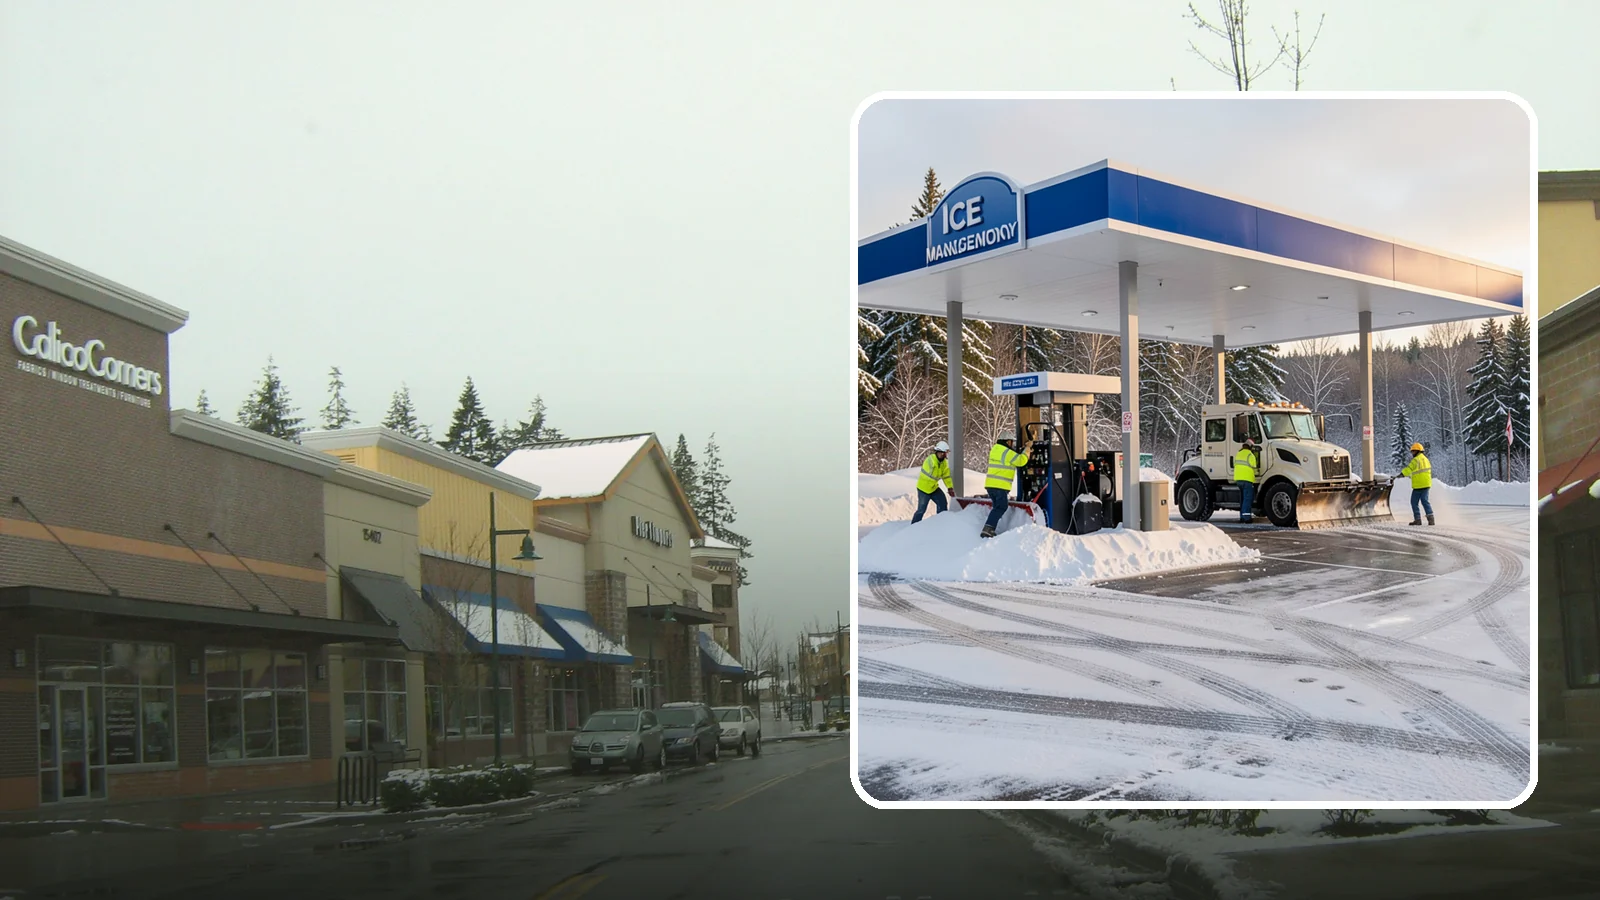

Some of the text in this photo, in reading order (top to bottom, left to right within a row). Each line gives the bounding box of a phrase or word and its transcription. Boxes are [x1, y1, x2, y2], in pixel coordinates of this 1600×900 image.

[943, 196, 982, 234] ICE
[13, 315, 162, 395] CalicoCorners
[17, 360, 47, 377] FABRICS
